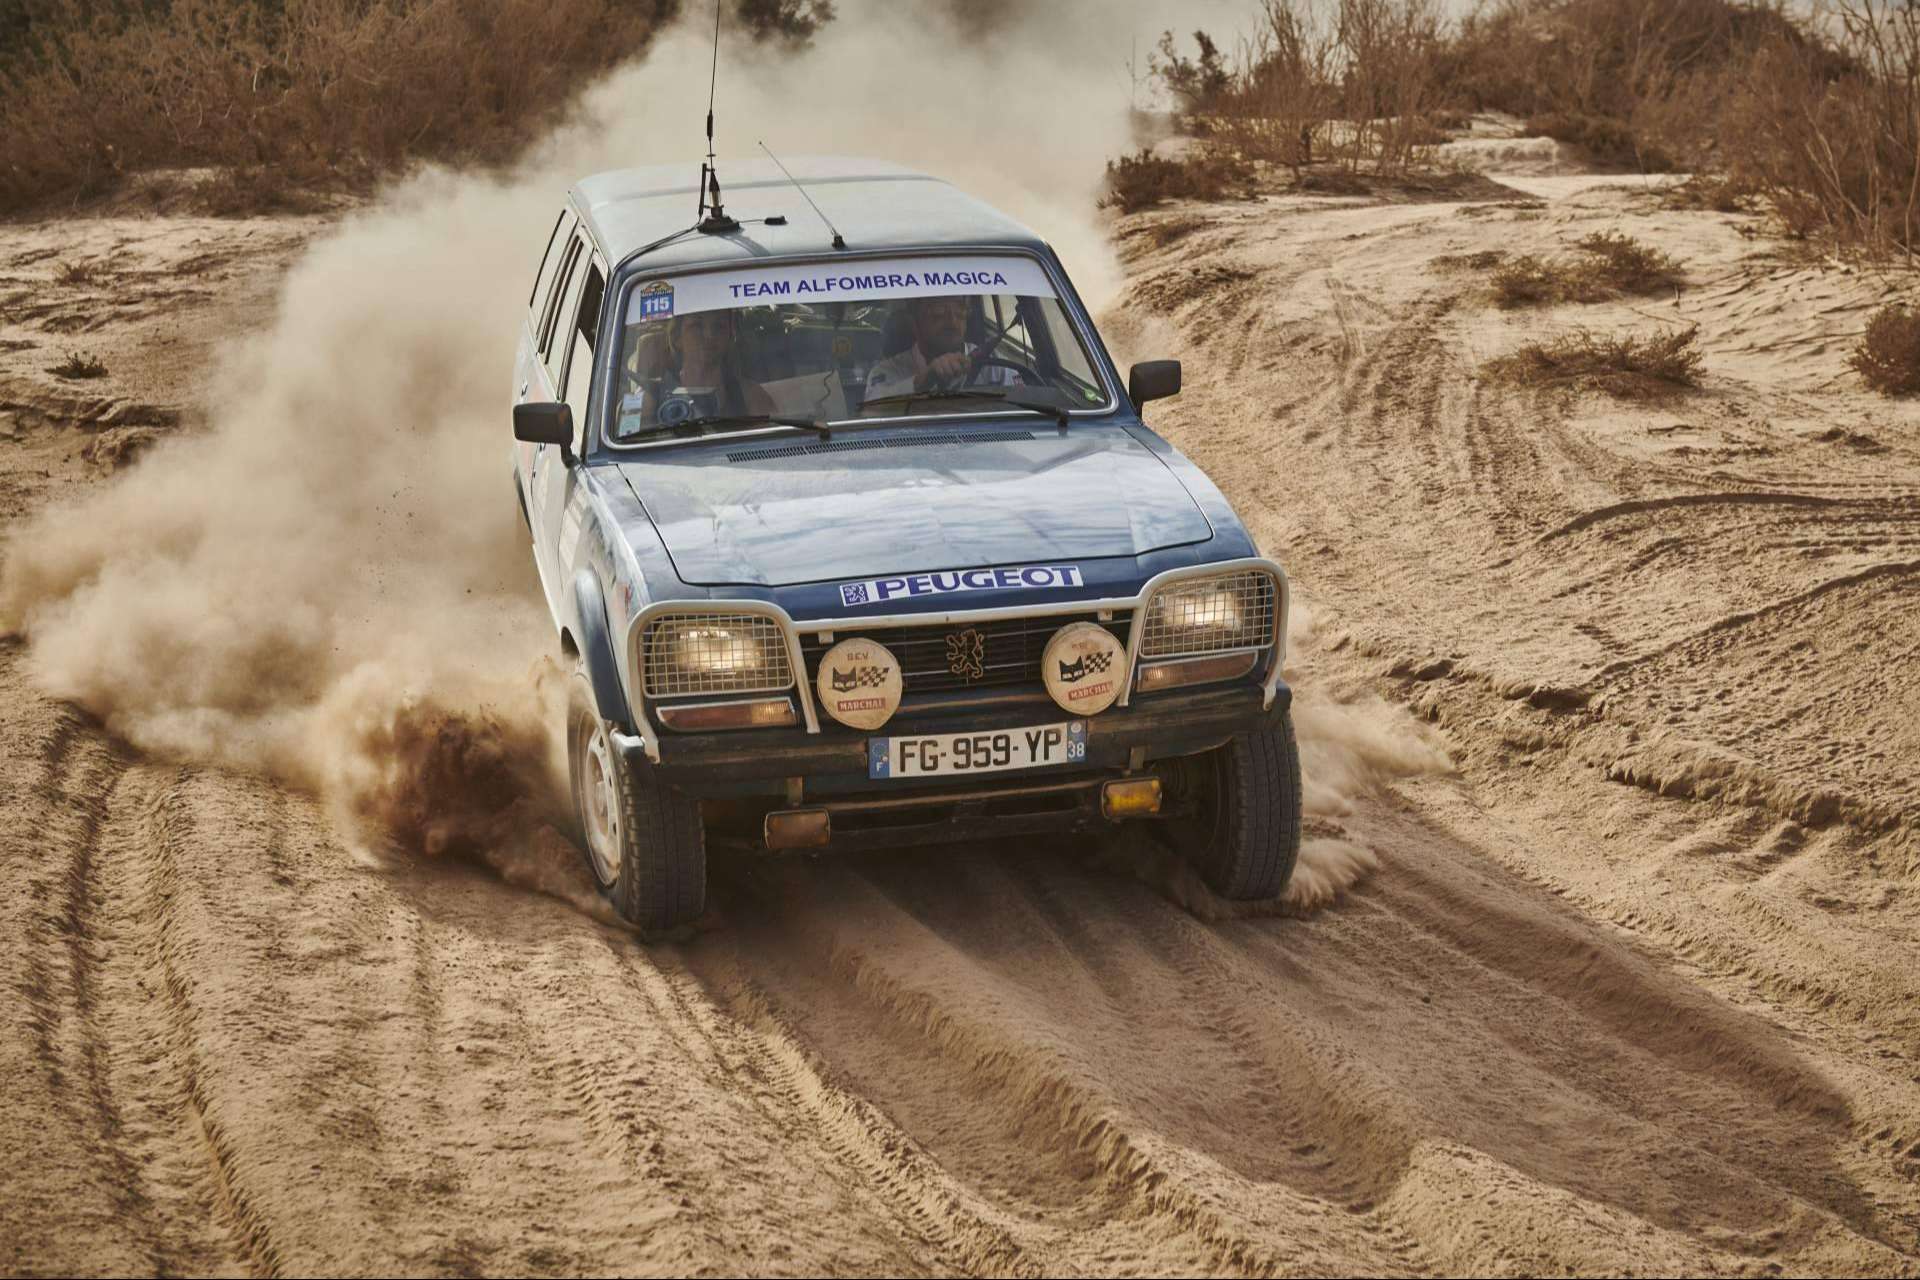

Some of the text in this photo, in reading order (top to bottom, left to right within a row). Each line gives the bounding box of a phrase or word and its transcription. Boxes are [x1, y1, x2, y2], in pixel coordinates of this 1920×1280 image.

[729, 272, 1007, 298] TEAM ALFOMBRA MAGICA
[644, 297, 669, 312] 115
[876, 567, 1076, 599] PEUGEOT
[840, 698, 883, 711] MARCHAL
[899, 729, 1061, 772] FG-959-YP
[1067, 741, 1085, 758] 38
[876, 761, 883, 771] F
